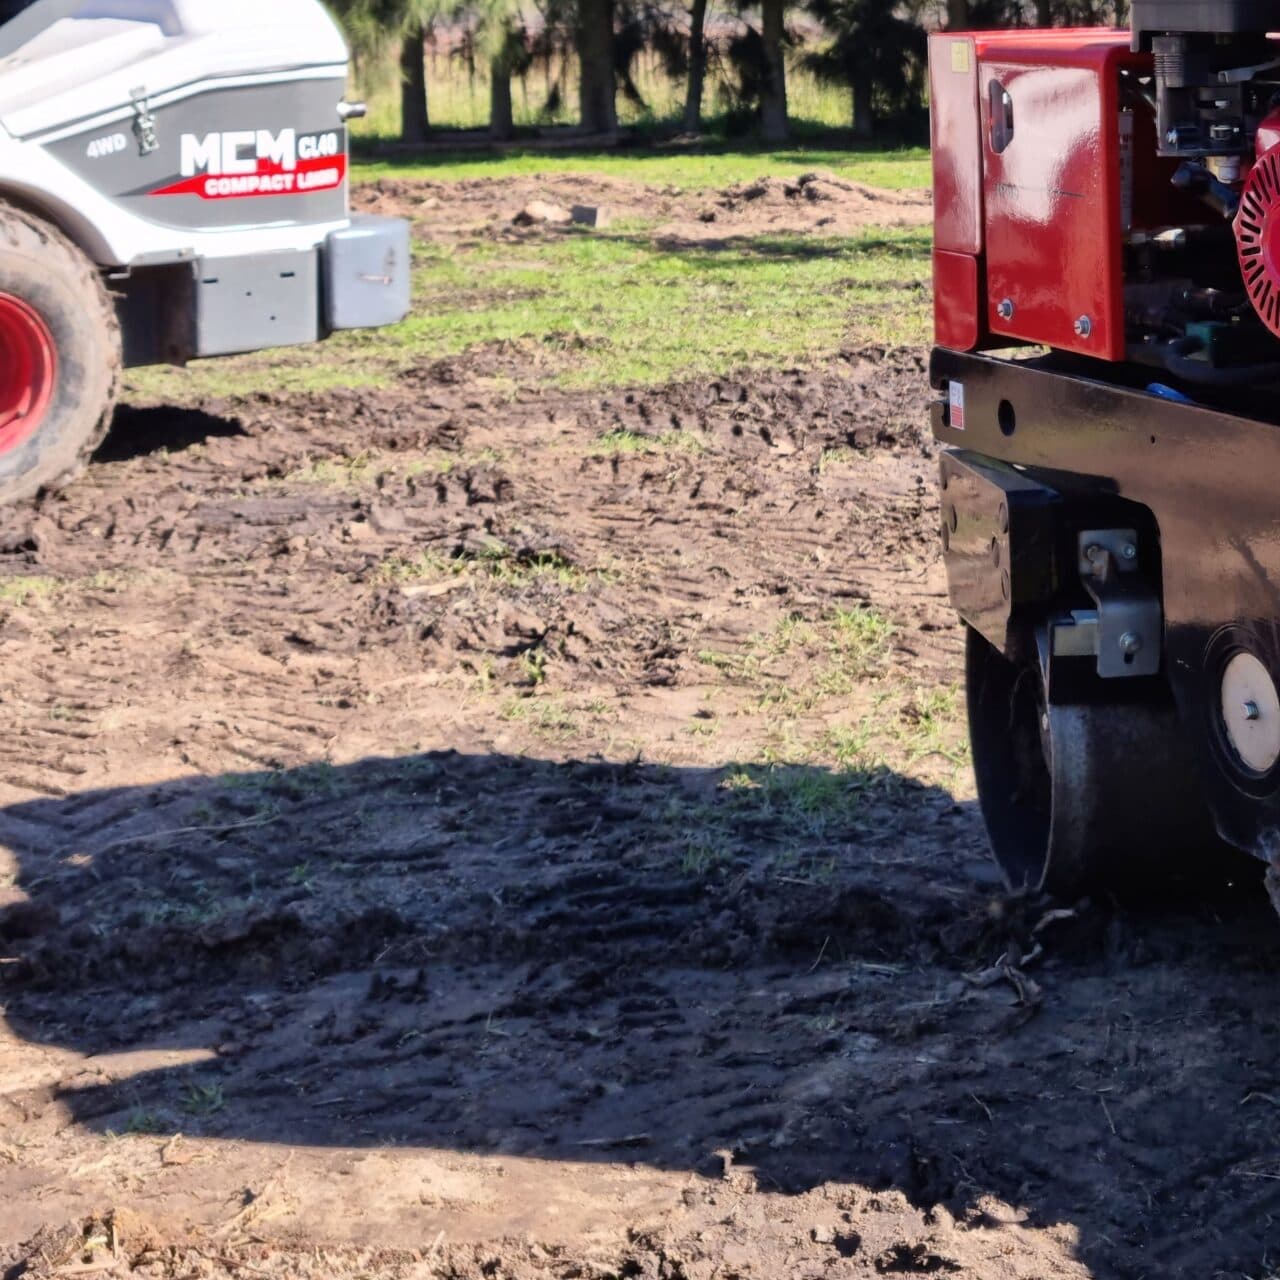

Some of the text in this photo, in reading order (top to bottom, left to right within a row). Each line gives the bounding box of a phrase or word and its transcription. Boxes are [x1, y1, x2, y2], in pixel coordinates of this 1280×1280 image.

[87, 133, 127, 158] 4WD
[180, 128, 296, 177] MCM
[204, 173, 294, 196] COMPACT
